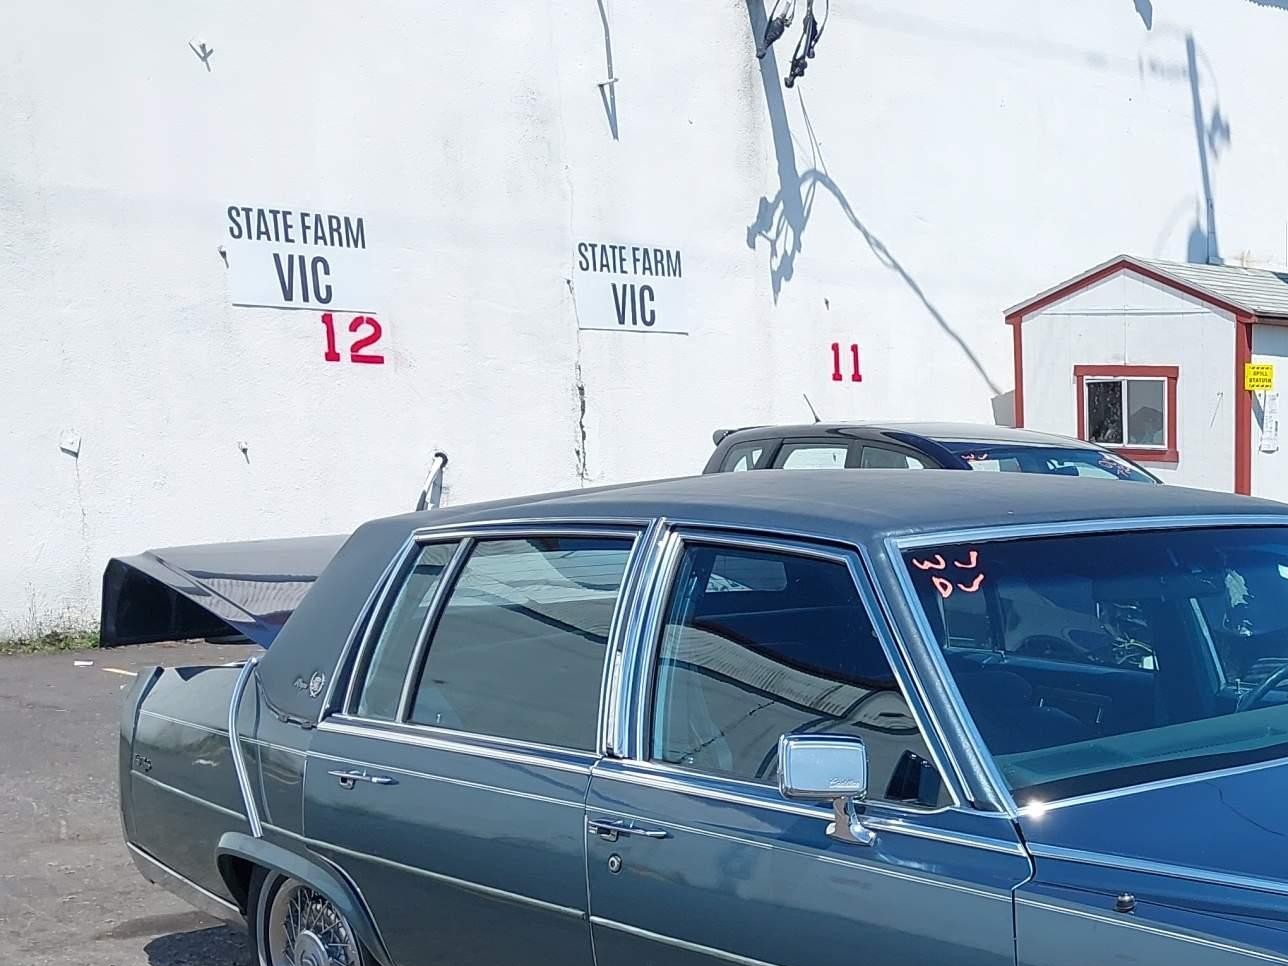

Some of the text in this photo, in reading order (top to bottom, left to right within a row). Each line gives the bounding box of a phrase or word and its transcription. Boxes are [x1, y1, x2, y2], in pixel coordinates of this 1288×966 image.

[227, 206, 366, 249] STATE FARM
[273, 253, 333, 304] VIC
[578, 242, 682, 278] STATE FARM
[611, 282, 656, 327] VIC
[321, 313, 384, 364] 12
[831, 342, 862, 382] 11
